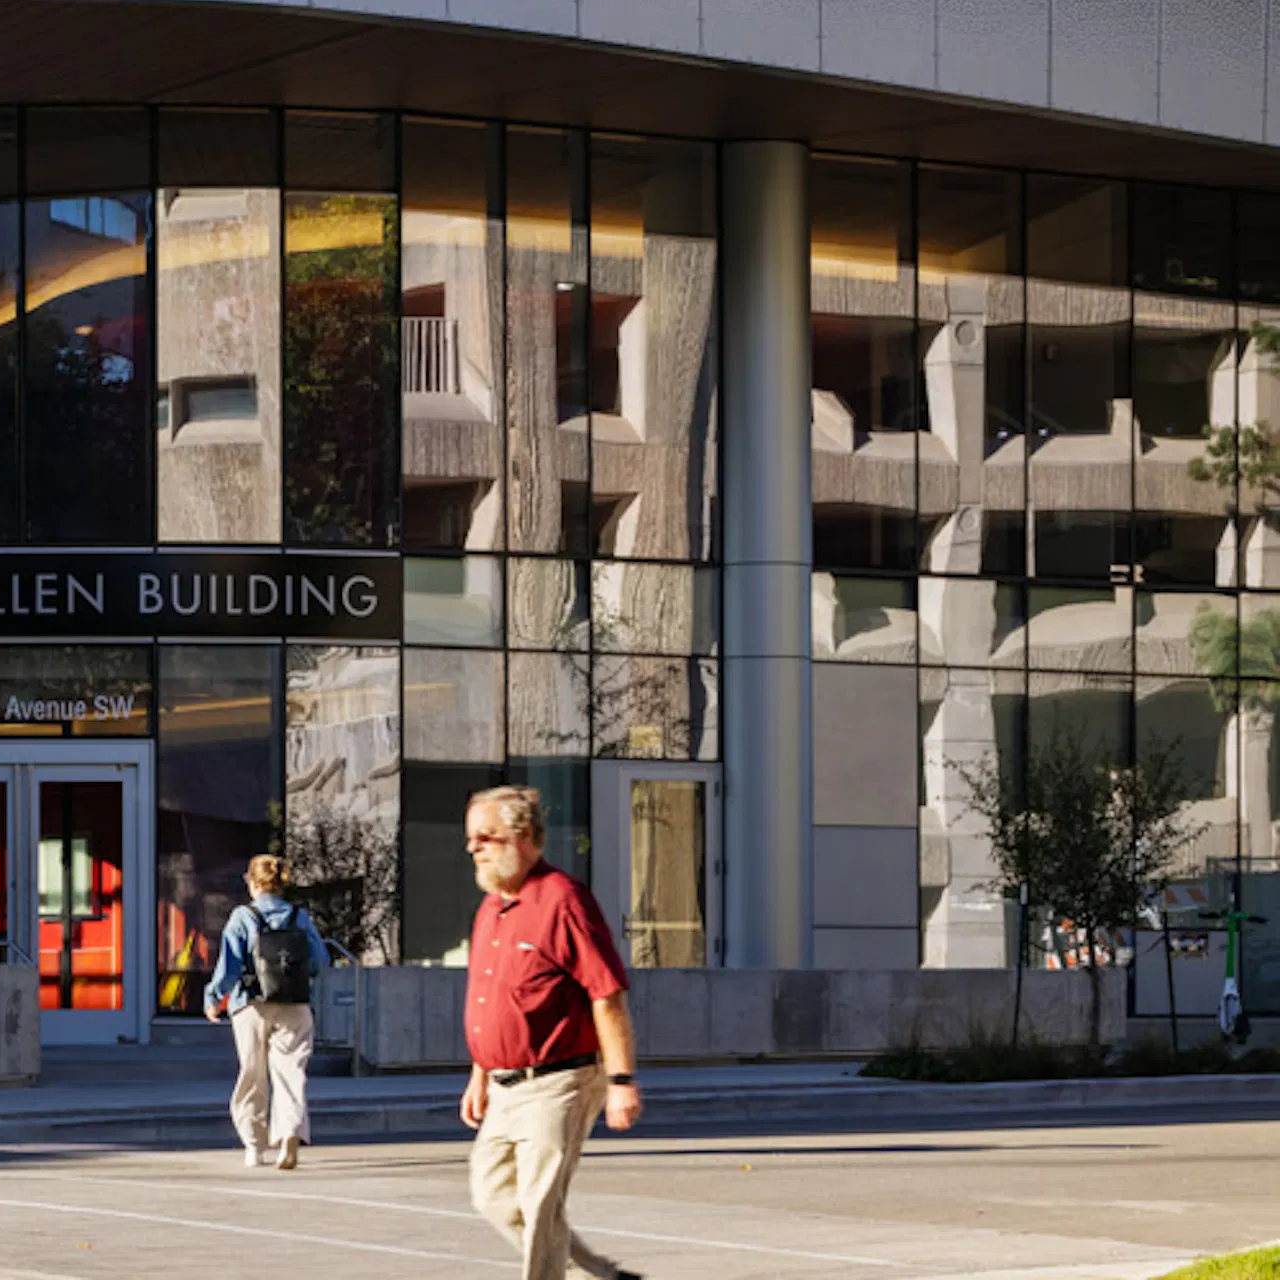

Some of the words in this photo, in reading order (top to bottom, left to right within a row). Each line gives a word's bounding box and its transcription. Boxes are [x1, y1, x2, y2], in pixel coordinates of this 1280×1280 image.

[138, 573, 379, 617] BUILDING
[4, 694, 87, 721] Avenue
[93, 694, 135, 721] SW
